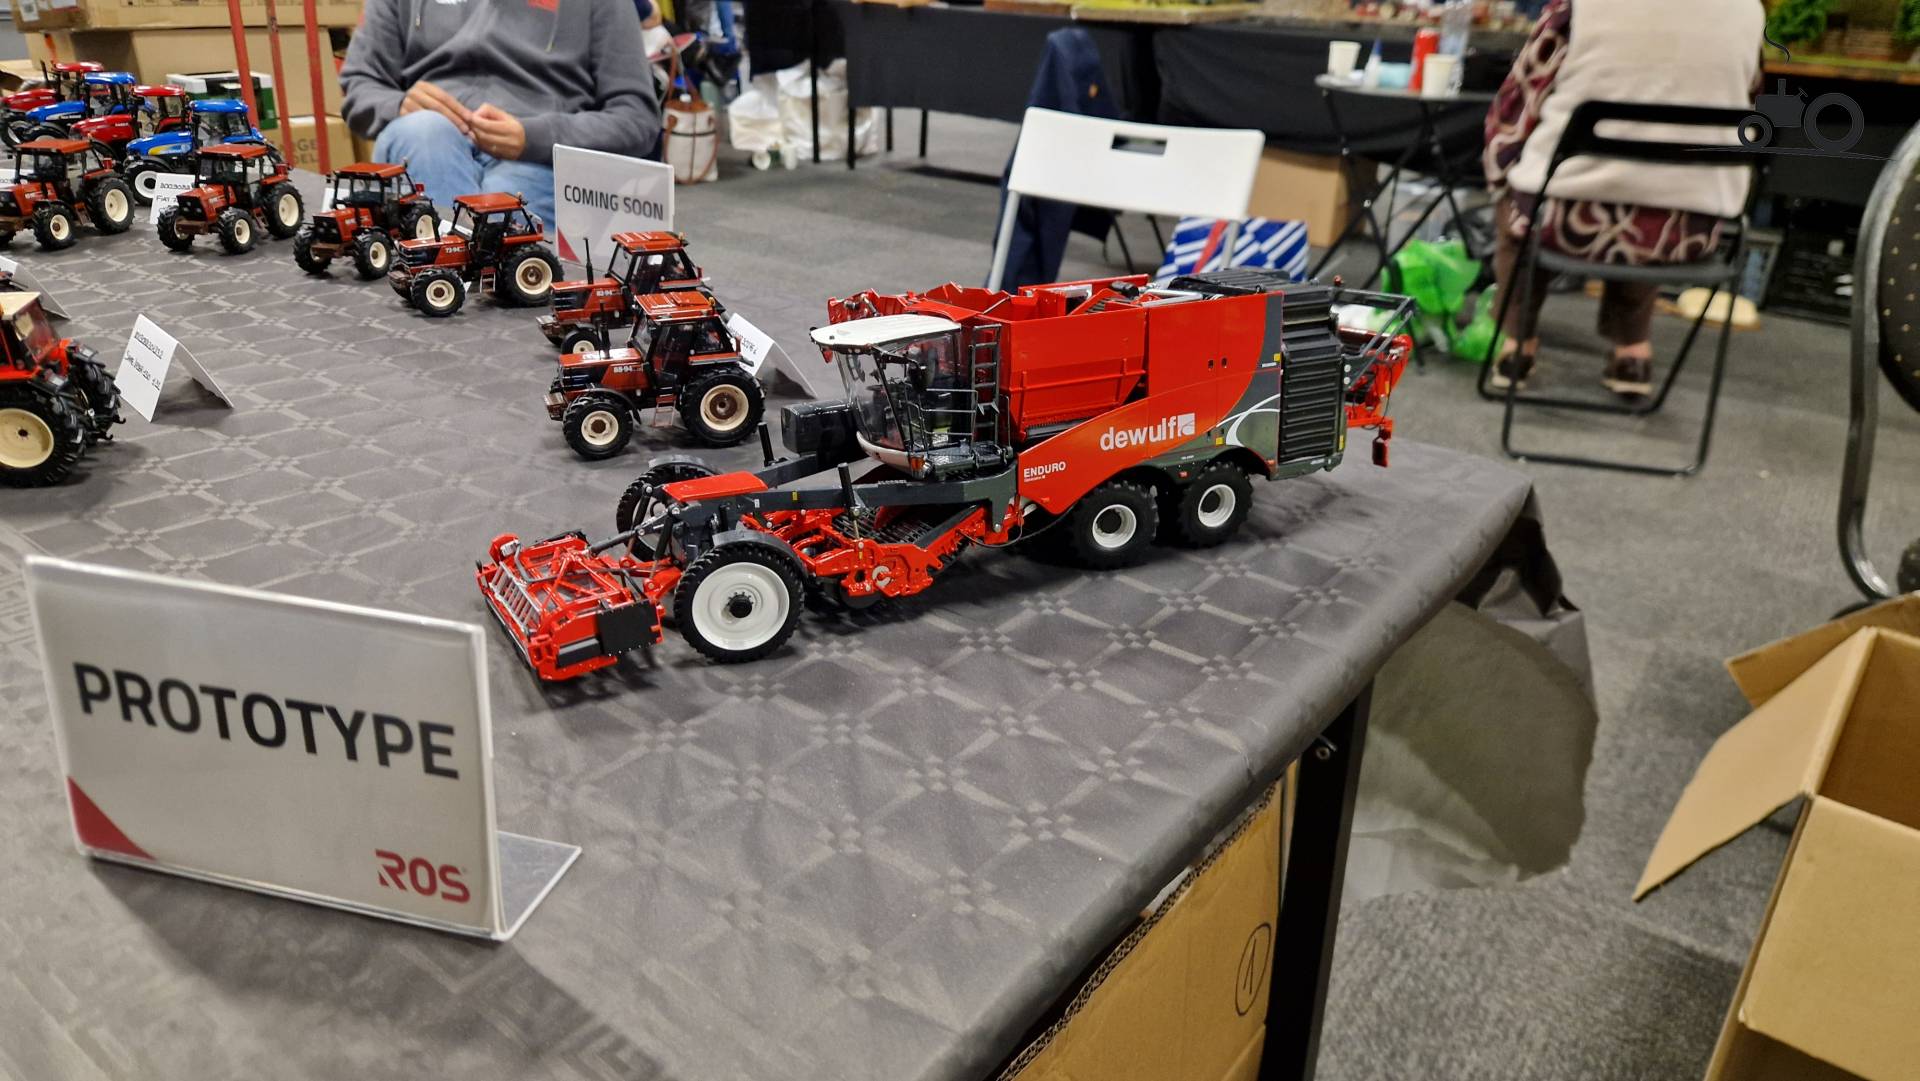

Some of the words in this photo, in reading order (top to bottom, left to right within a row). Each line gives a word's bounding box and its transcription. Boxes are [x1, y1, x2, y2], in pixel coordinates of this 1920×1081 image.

[564, 184, 619, 212] COMING
[623, 197, 664, 221] SOON
[1100, 415, 1177, 451] dewulf
[1023, 461, 1067, 478] ENDURO
[72, 661, 460, 780] PROTOTYPE
[375, 849, 470, 903] ROS
